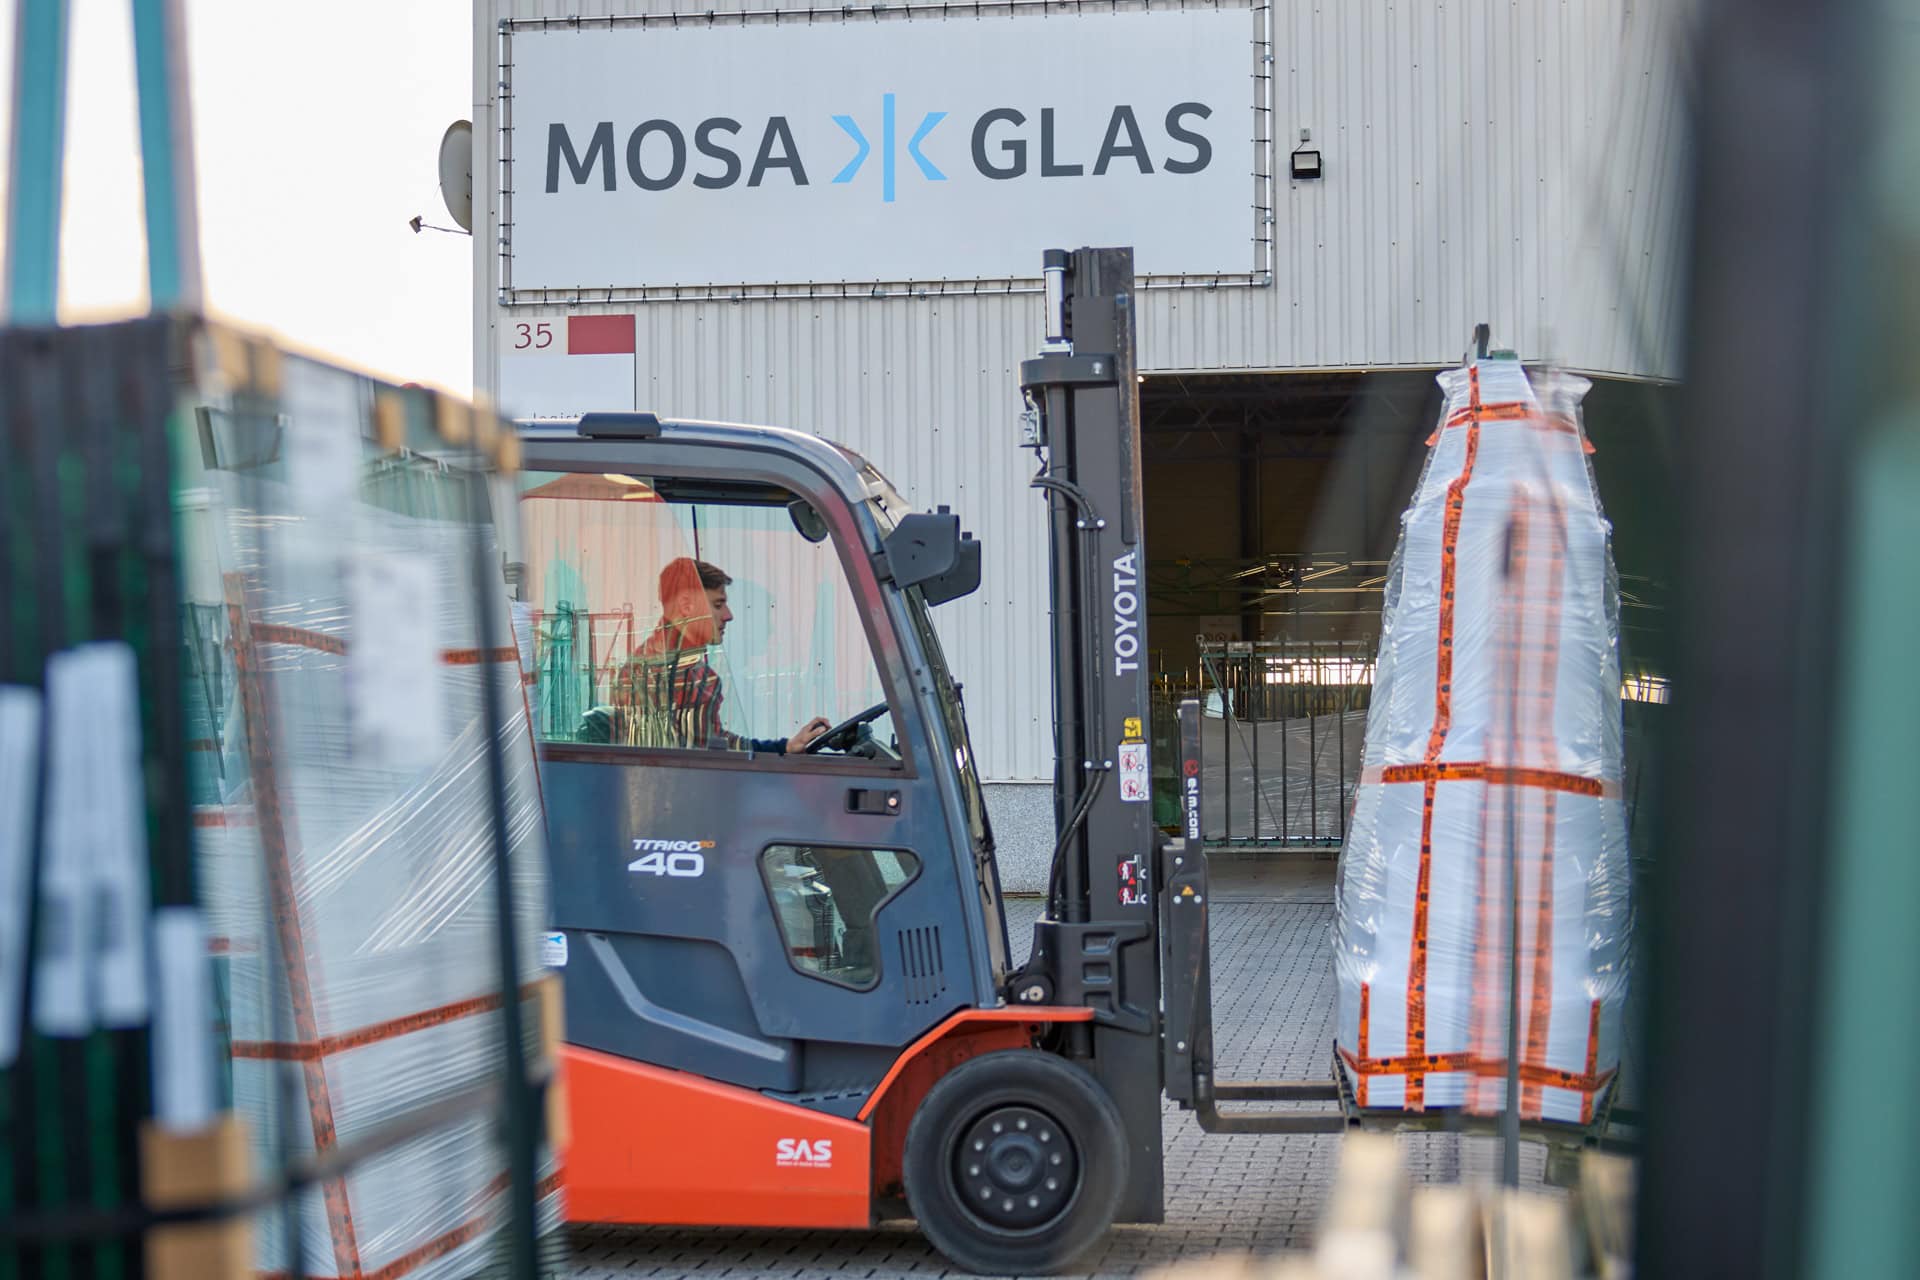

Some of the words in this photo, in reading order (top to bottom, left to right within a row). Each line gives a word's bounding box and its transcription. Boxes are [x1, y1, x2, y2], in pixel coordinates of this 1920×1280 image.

[544, 116, 810, 194] MOSA
[970, 101, 1214, 181] GLAS
[514, 323, 553, 349] 35
[1113, 552, 1138, 677] TOYOTA
[628, 852, 704, 877] 40
[776, 1138, 832, 1161] SAS
